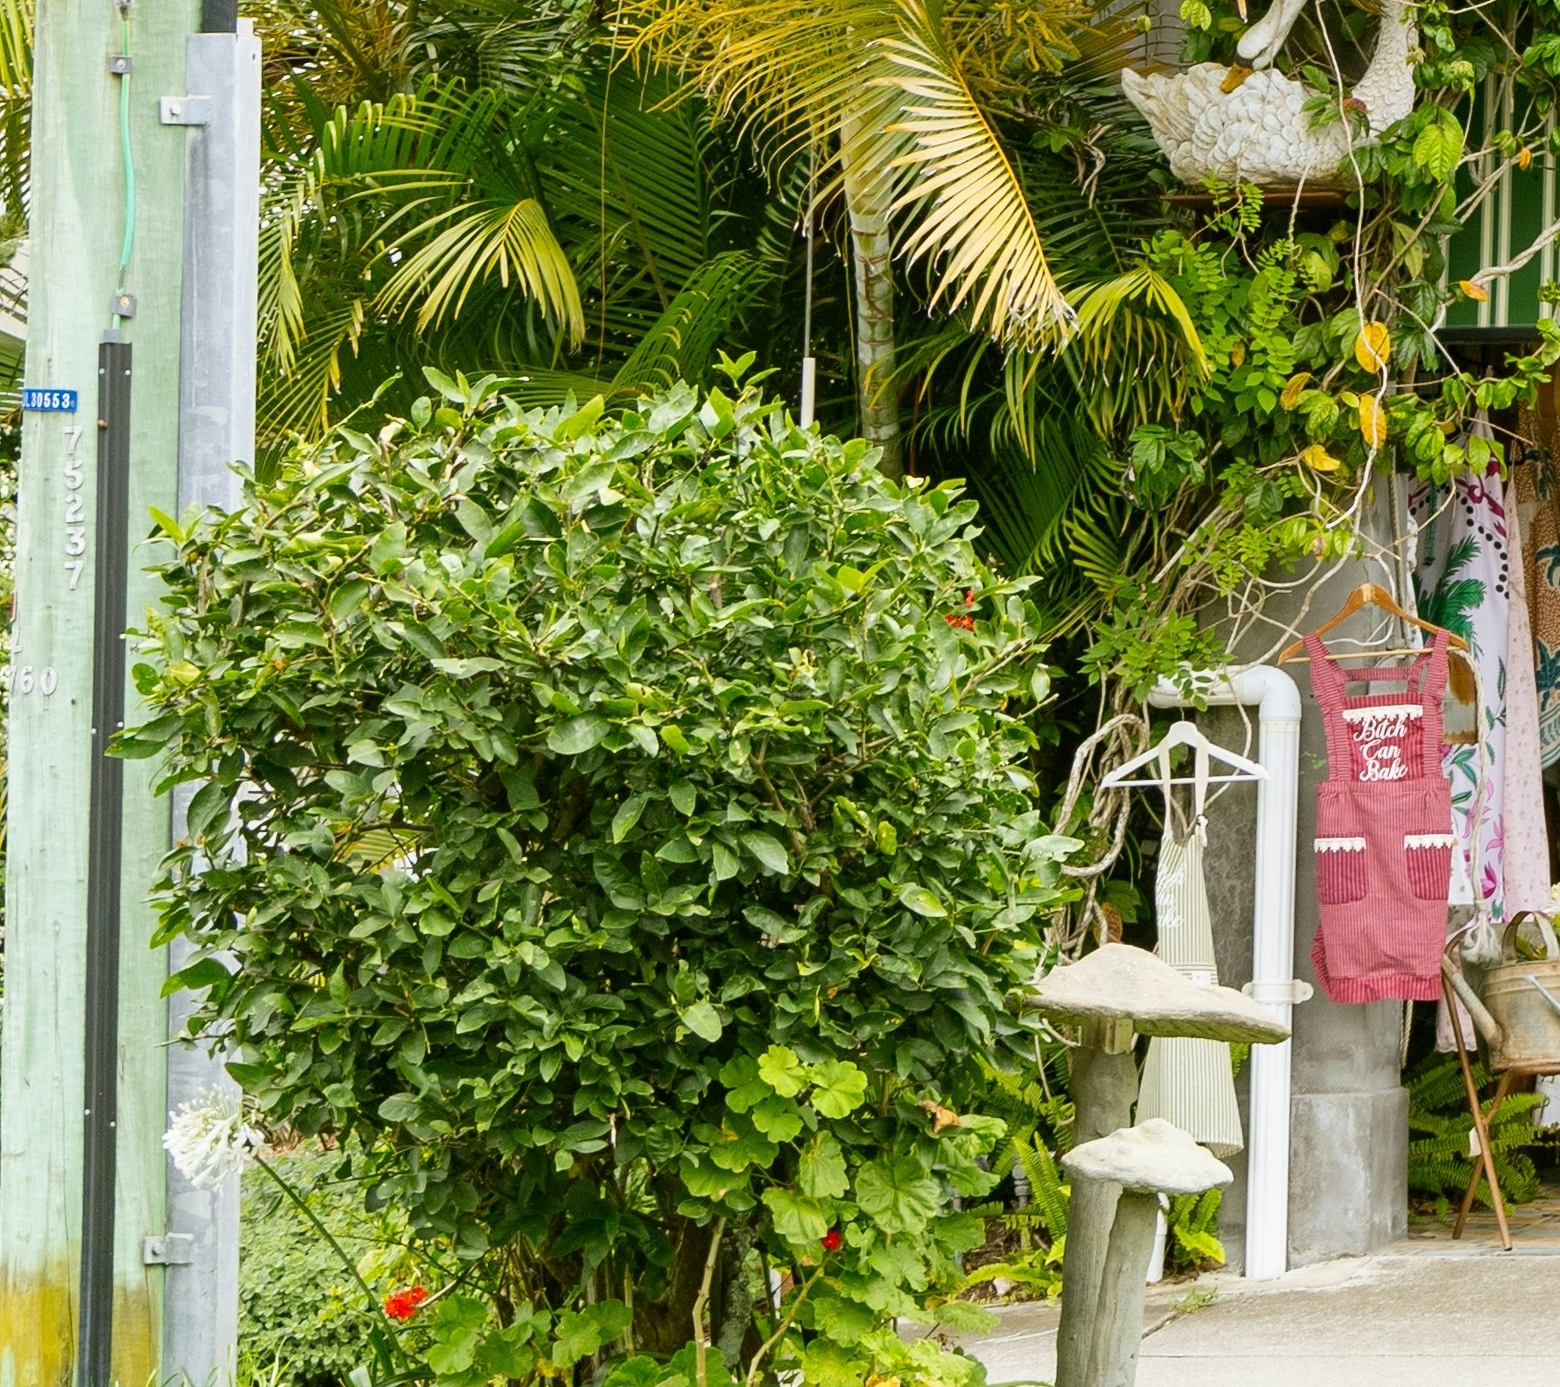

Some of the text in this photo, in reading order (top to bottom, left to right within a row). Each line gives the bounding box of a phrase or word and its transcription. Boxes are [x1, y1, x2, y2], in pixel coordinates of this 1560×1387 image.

[22, 391, 70, 409] L30553
[63, 425, 87, 591] 75237
[1353, 715, 1408, 742] Bitch
[1359, 738, 1401, 761] Can
[1359, 757, 1409, 782] Bake
